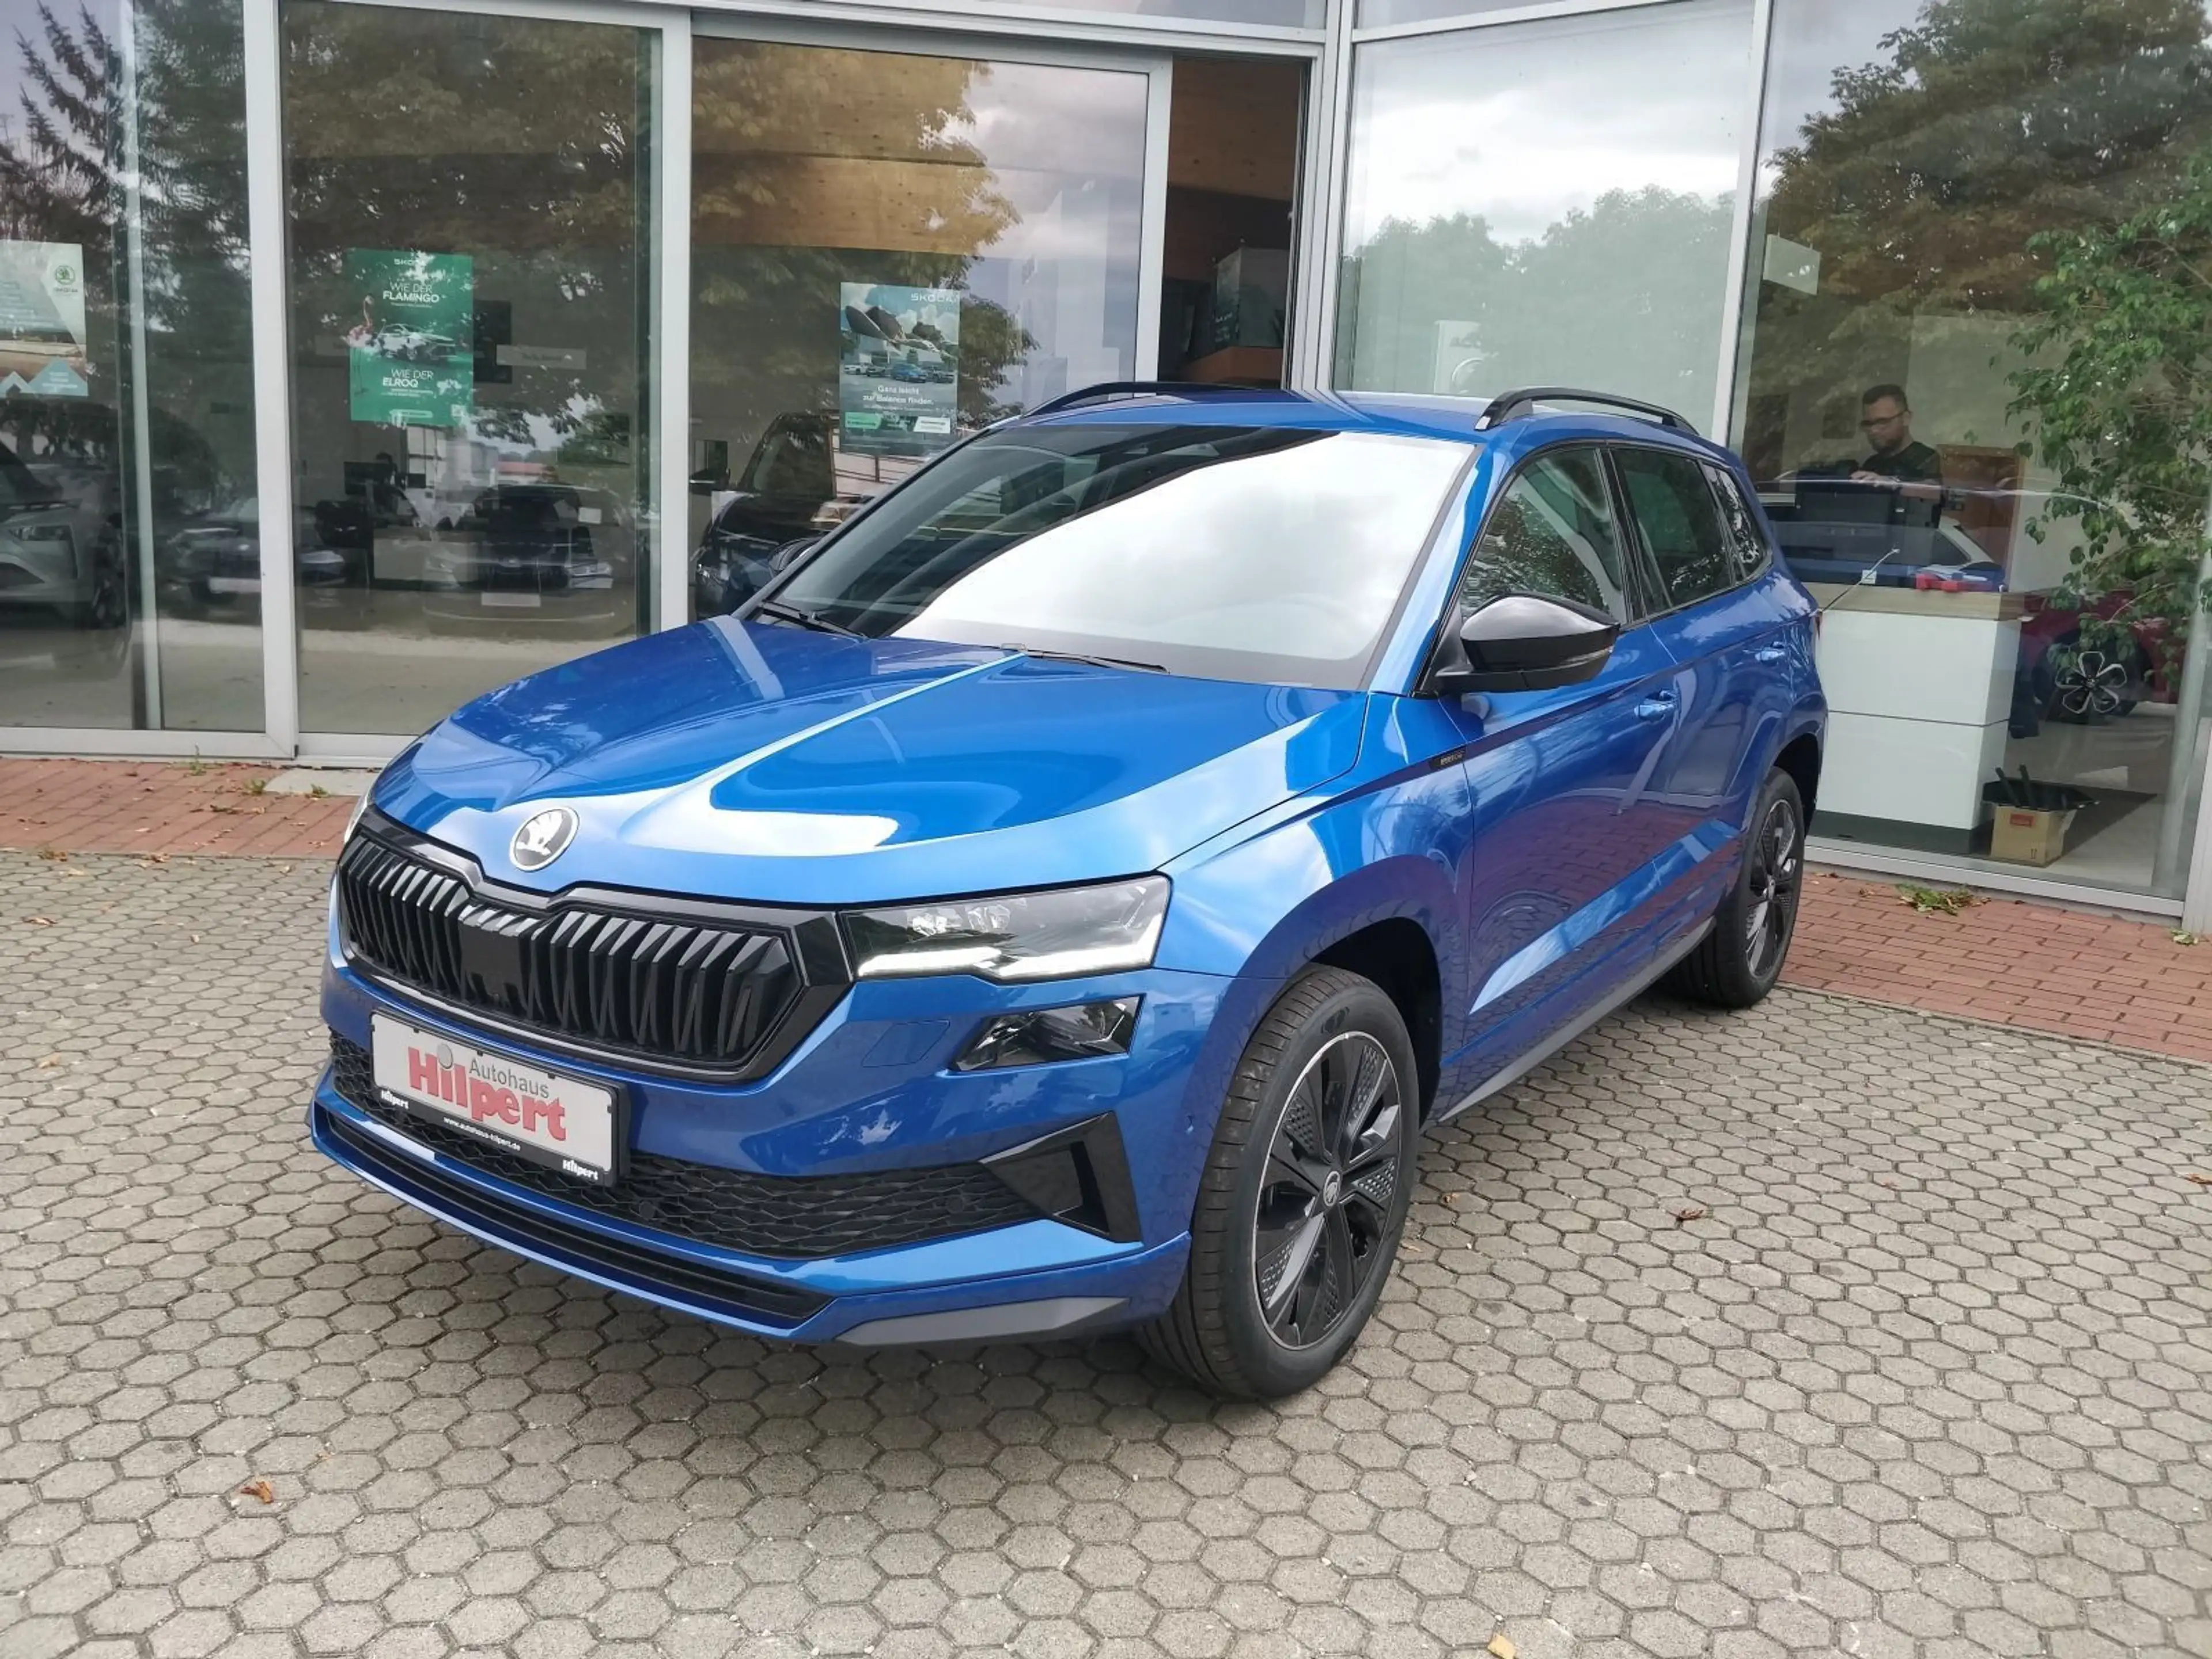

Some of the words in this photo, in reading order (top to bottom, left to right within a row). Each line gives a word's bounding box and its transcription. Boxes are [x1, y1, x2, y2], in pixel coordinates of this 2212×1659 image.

[390, 281, 410, 292] WIE
[412, 283, 433, 294] DER
[382, 290, 440, 303] FLAMINGO
[391, 369, 411, 378] WIE
[412, 370, 434, 380] DER
[382, 377, 419, 388] ELROQ
[877, 385, 897, 393] Ganz
[468, 1058, 550, 1099] Autohaus
[408, 1043, 566, 1142] Hilpert
[381, 1089, 409, 1110] Hilpert
[563, 1158, 599, 1181] Hilpert
